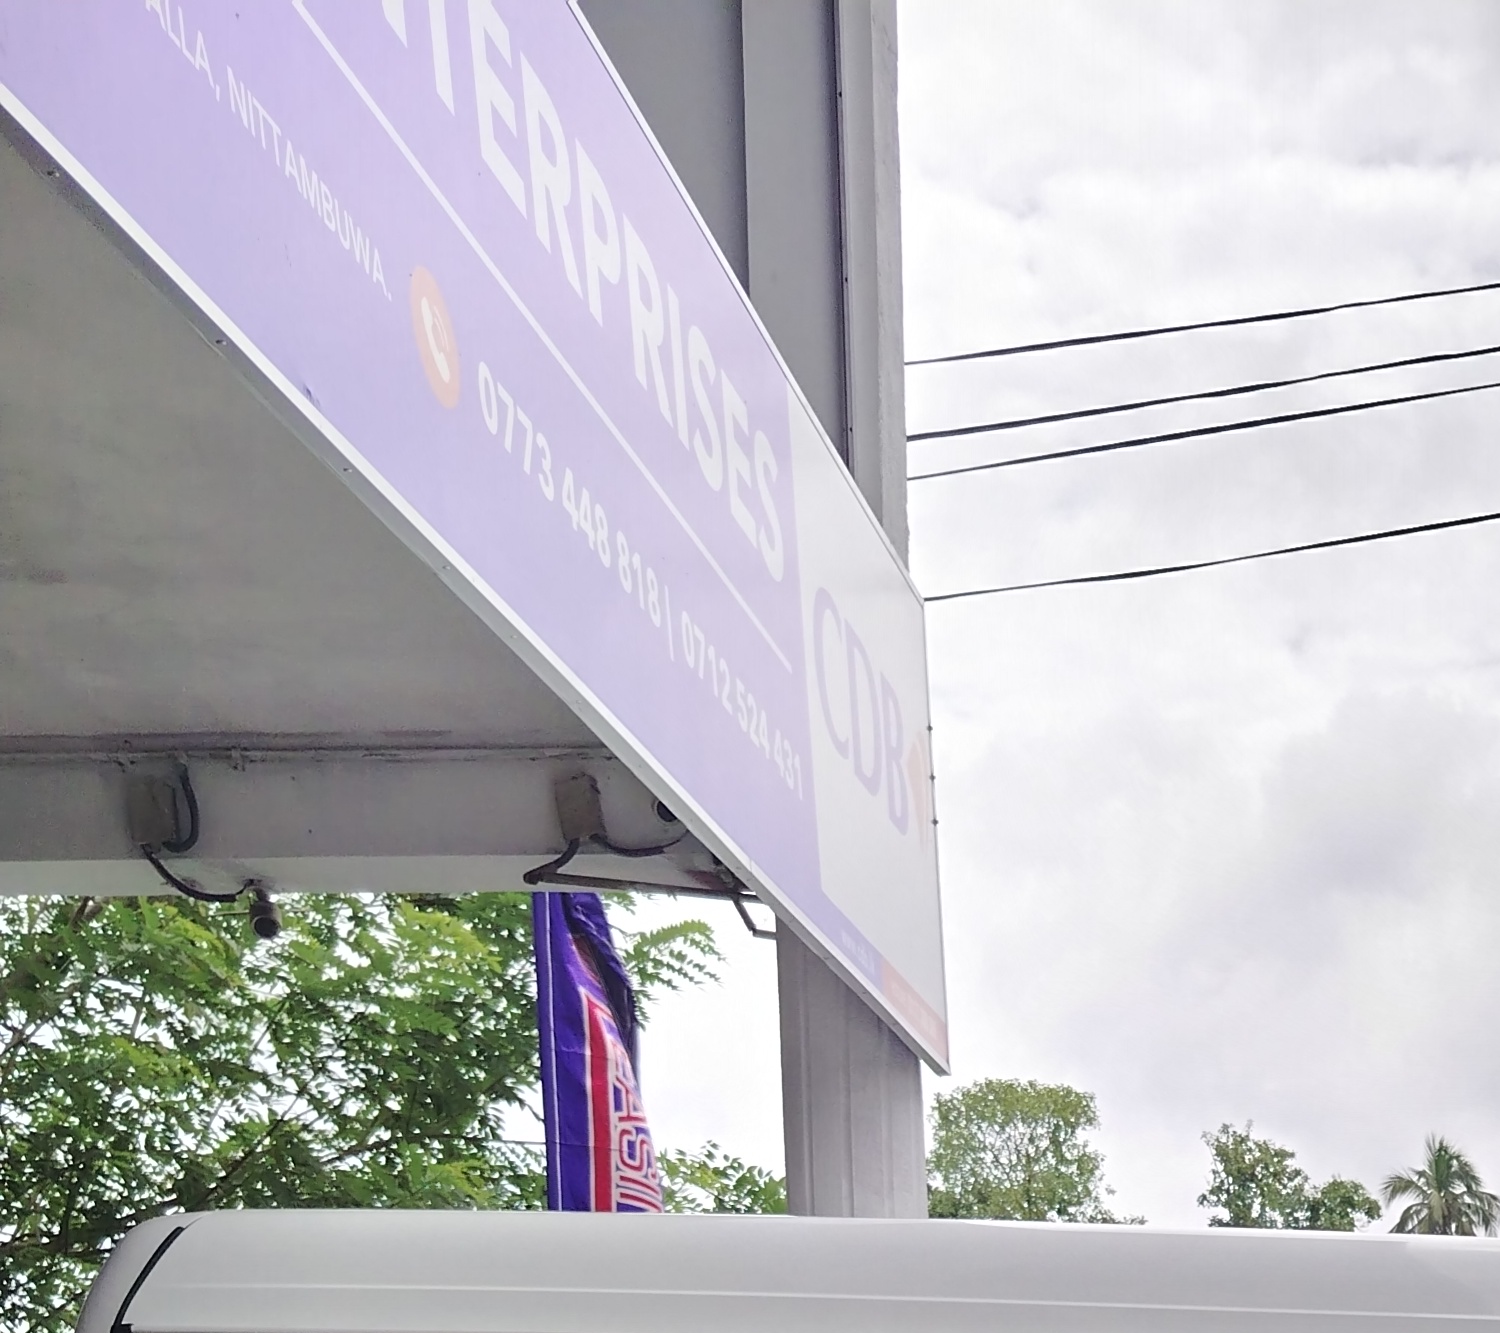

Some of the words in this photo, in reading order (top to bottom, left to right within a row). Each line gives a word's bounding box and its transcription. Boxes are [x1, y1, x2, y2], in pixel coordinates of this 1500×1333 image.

[227, 65, 392, 301] NITTAMBUWA.
[382, 0, 784, 582] TERPRISES
[478, 361, 554, 502] 0773
[562, 466, 611, 568] 448
[616, 530, 661, 628] 818
[681, 610, 733, 716] 0712
[735, 681, 770, 759] 524
[773, 729, 803, 800] 431
[813, 586, 909, 836] CDB
